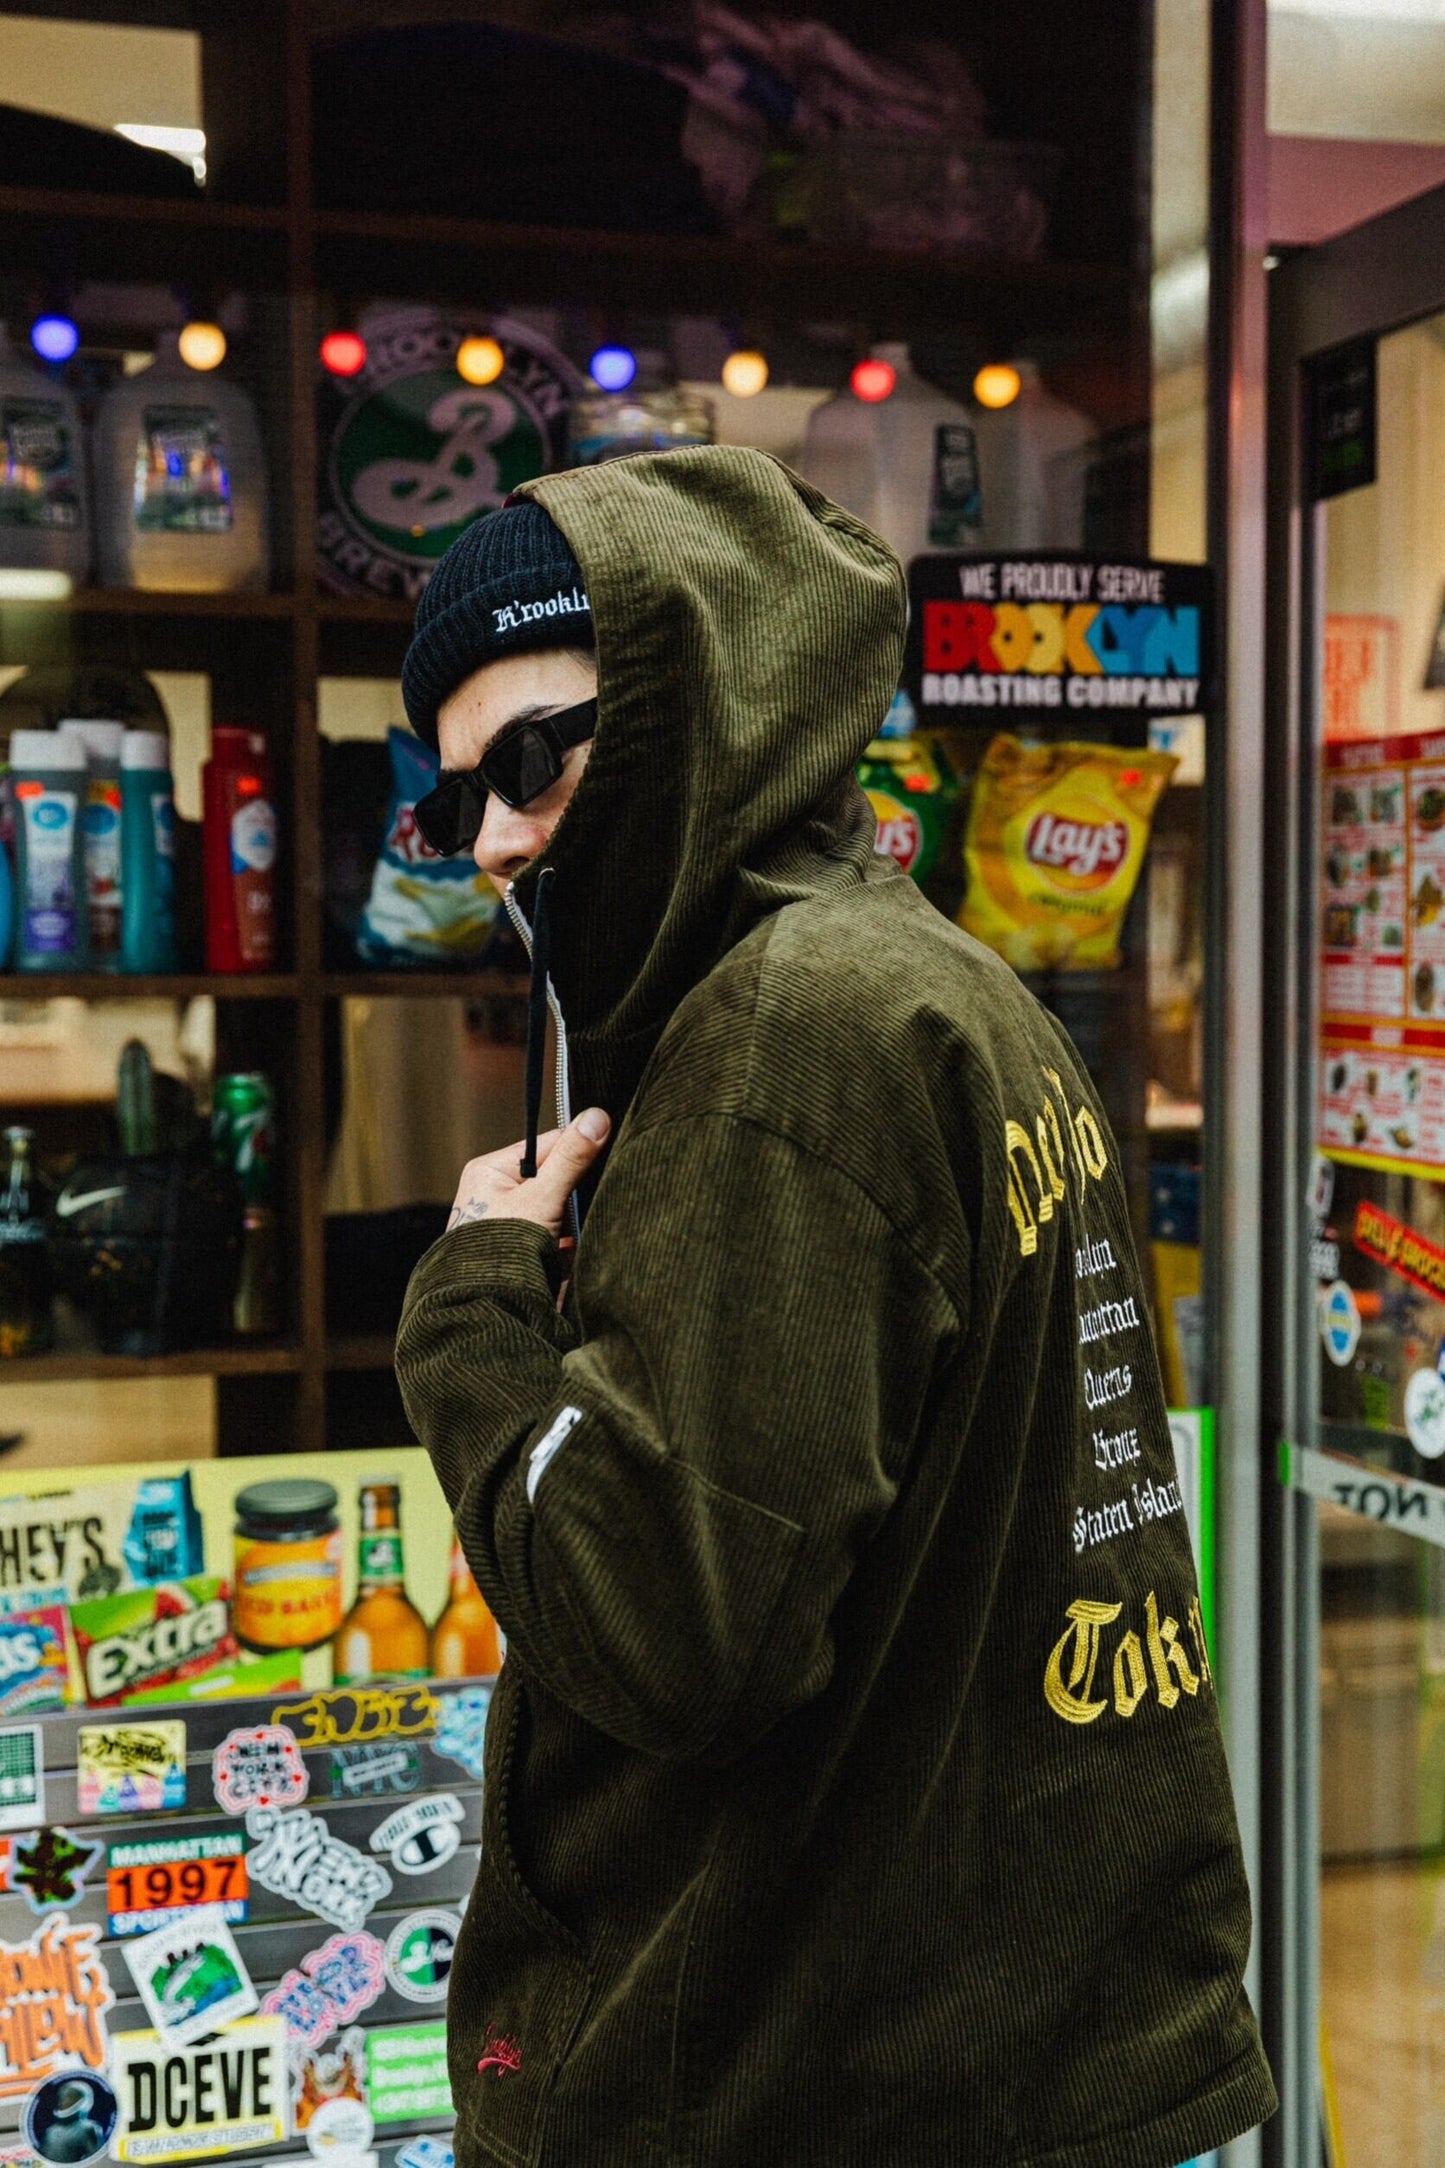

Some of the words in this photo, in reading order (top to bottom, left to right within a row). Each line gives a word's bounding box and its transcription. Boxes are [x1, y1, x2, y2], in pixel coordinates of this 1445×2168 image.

[958, 563, 996, 599] WE
[999, 562, 1093, 600] PROUDLY
[1096, 565, 1165, 603] SERVE
[922, 602, 1199, 675] BROOKLYN
[921, 673, 1062, 707] ROASTING
[1066, 676, 1200, 709] COMPANY
[1031, 812, 1123, 877] Lay's
[1091, 1427, 1142, 1472] Bronx
[1071, 1499, 1135, 1553] Staten
[1131, 1474, 1183, 1525] Islan
[86, 1598, 228, 1701] Extra
[116, 1860, 237, 1909] 1997
[127, 2046, 273, 2134] DCEVE
